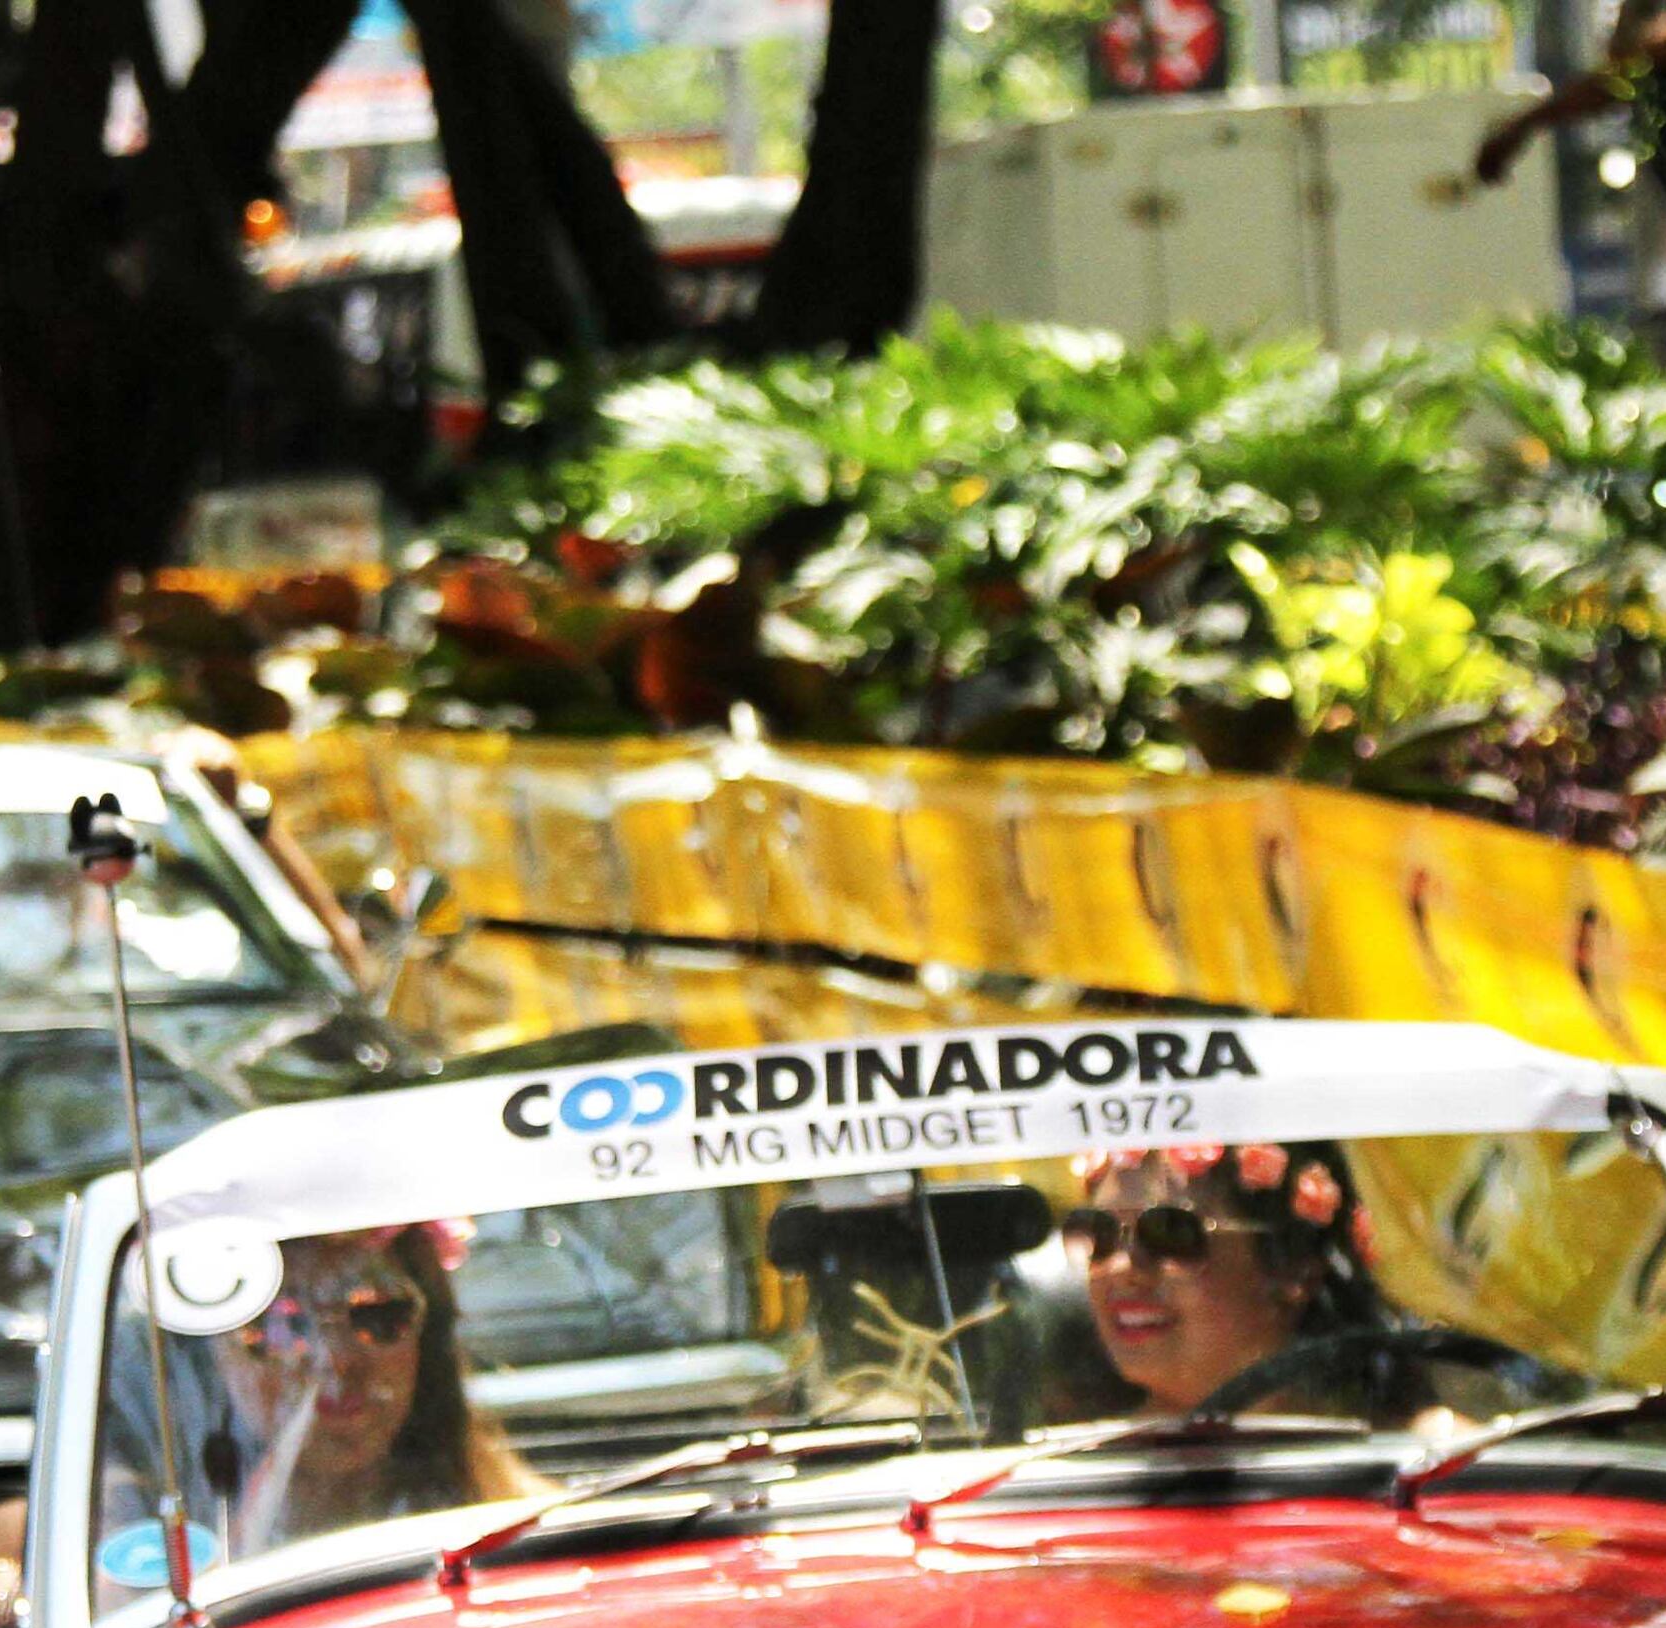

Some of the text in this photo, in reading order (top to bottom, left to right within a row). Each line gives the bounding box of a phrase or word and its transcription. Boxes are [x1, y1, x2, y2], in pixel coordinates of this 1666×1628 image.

[589, 1093, 1200, 1181] 92 MG MIDGET 1972
